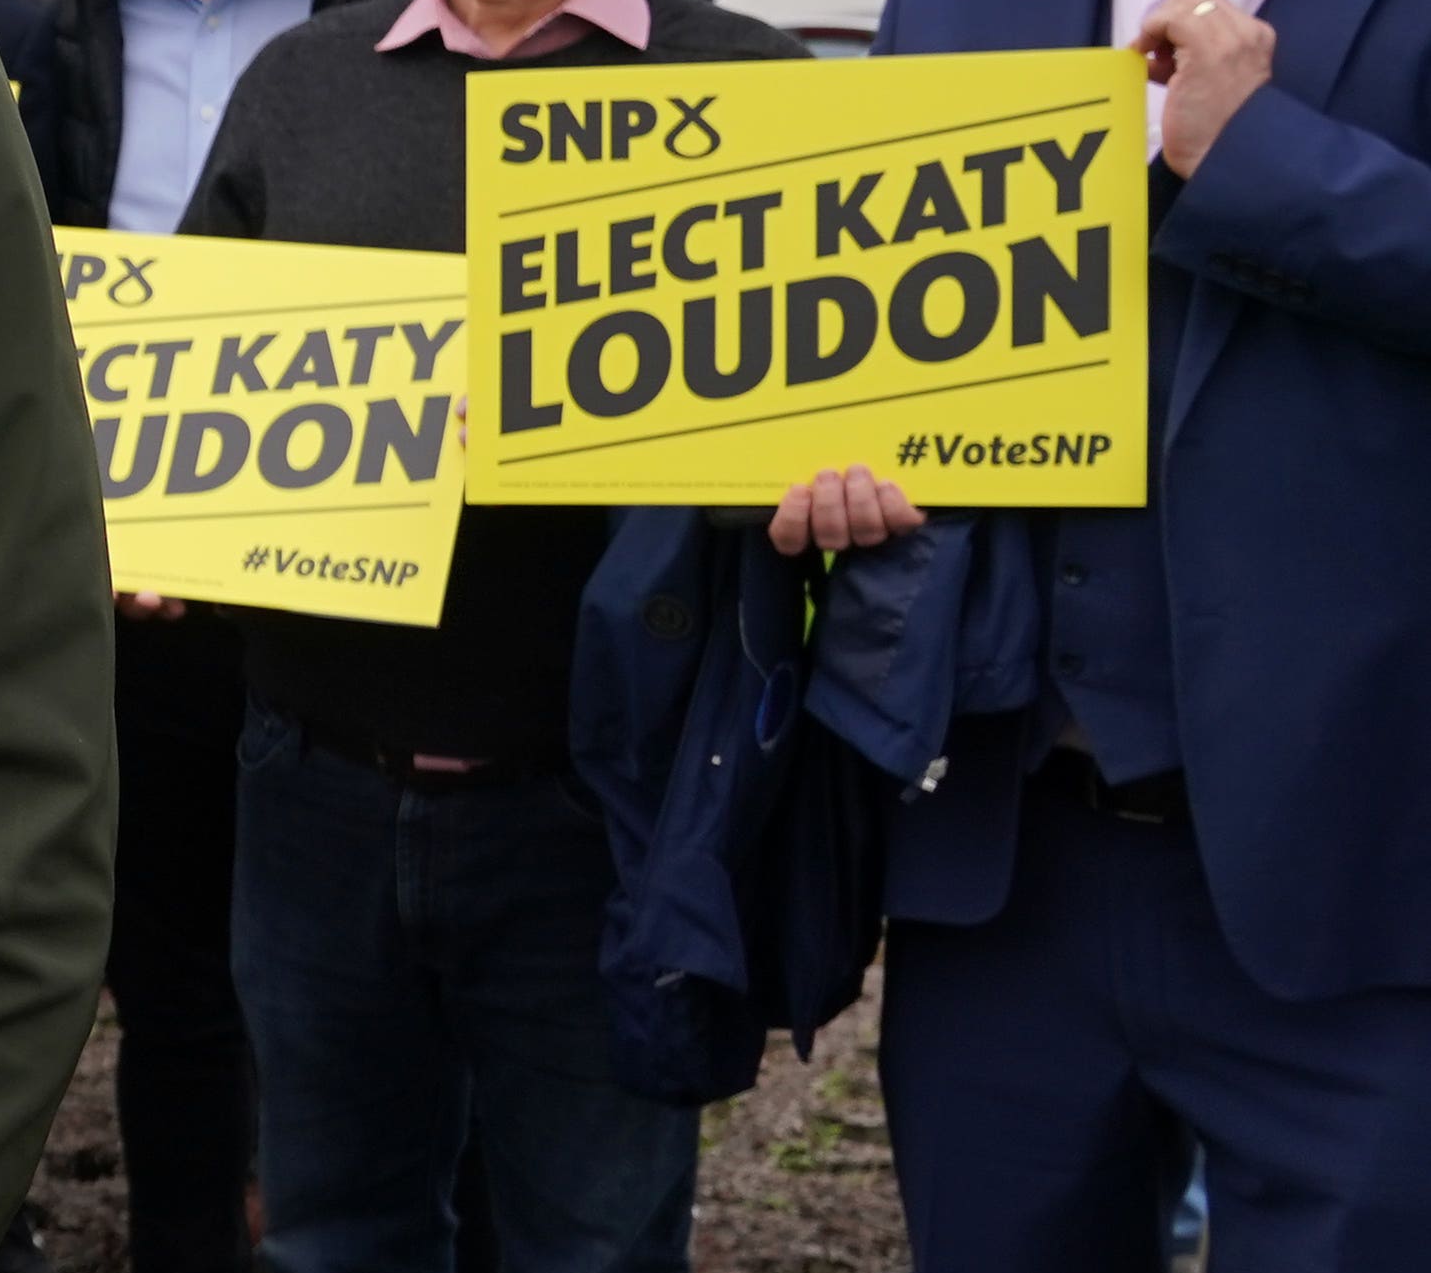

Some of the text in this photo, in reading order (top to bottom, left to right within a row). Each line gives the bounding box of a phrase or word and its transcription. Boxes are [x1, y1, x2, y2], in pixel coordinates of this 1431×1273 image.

[499, 99, 656, 164] SNP
[499, 130, 1110, 315] ELECT KATY
[210, 320, 465, 396] KATY
[499, 225, 1111, 435] LOUDON
[92, 395, 452, 499] UDON
[898, 434, 1112, 466] #VoteSNP
[243, 545, 419, 588] #VoteSNP
